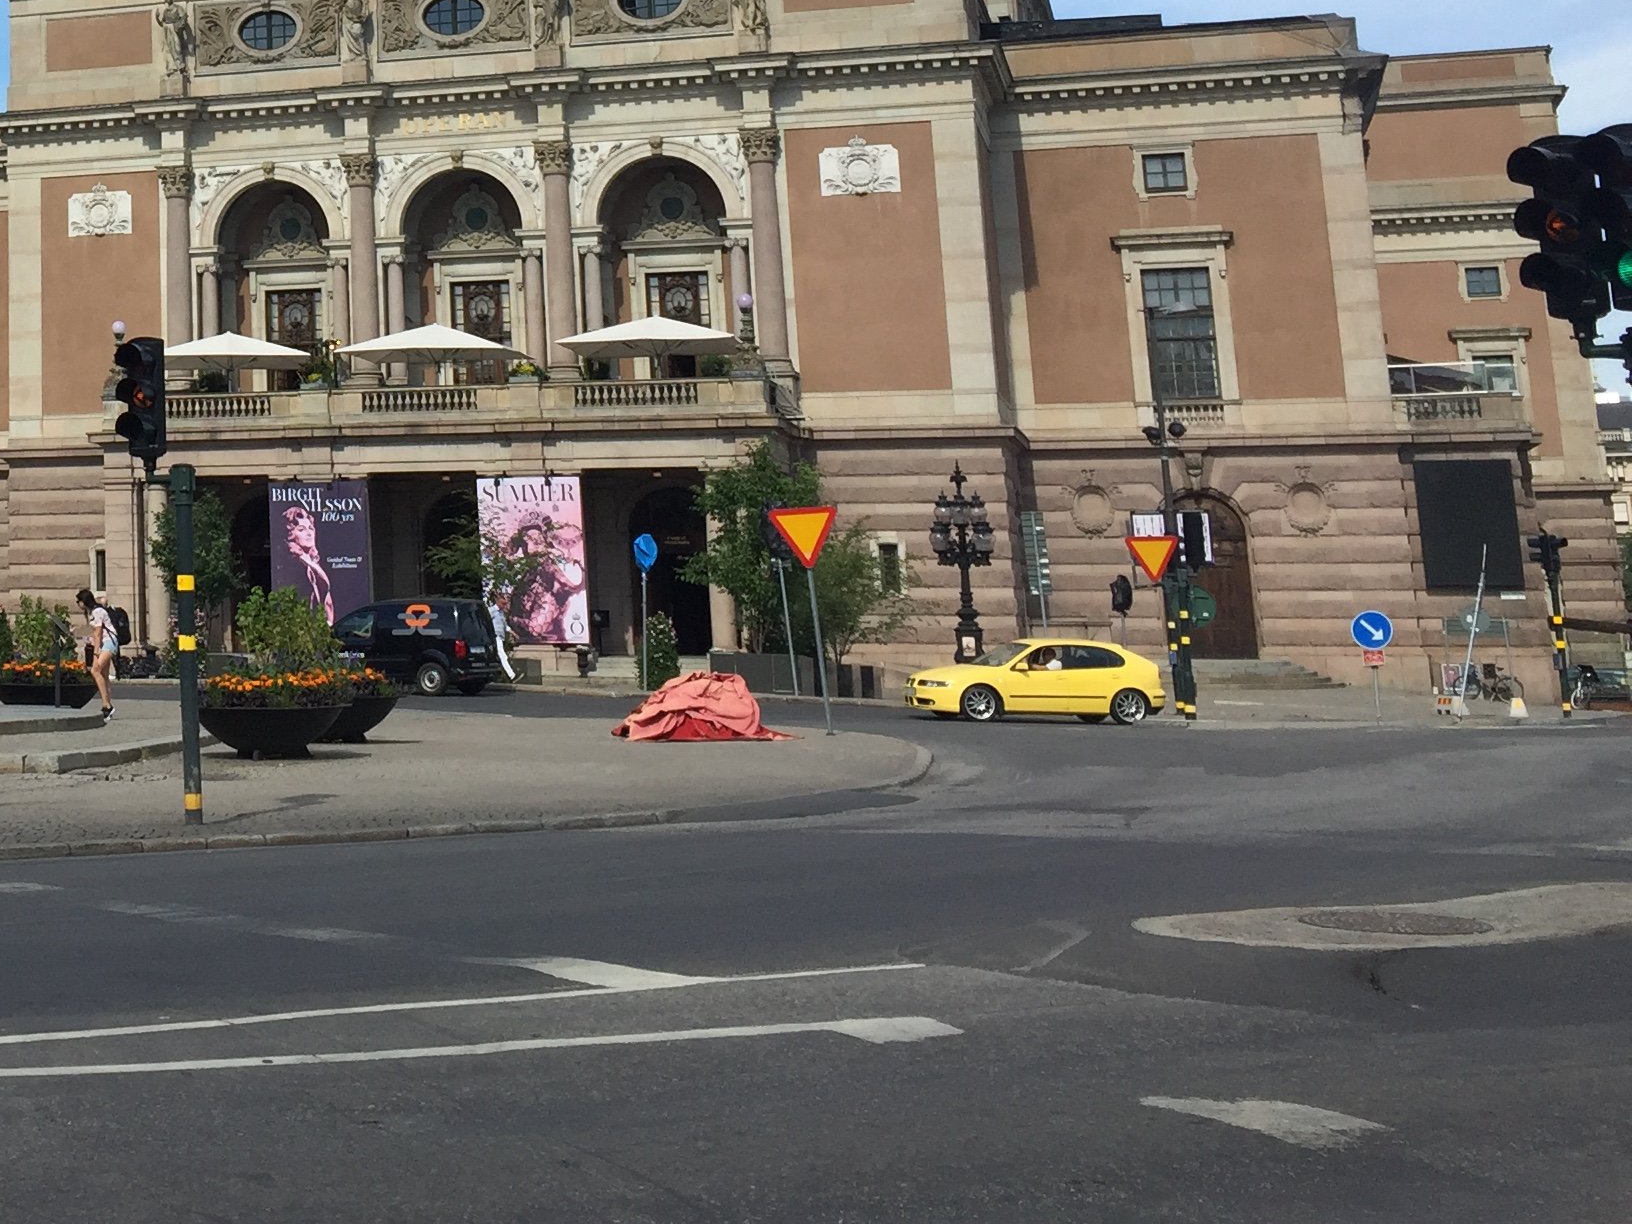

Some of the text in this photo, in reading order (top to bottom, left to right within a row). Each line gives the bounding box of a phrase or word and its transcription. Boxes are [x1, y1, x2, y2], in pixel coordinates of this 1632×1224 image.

[403, 111, 506, 136] OPERAN
[272, 487, 323, 502] BIRGIT
[482, 483, 575, 504] SUMMER
[298, 497, 362, 512] NILSSON
[321, 511, 340, 522] 100
